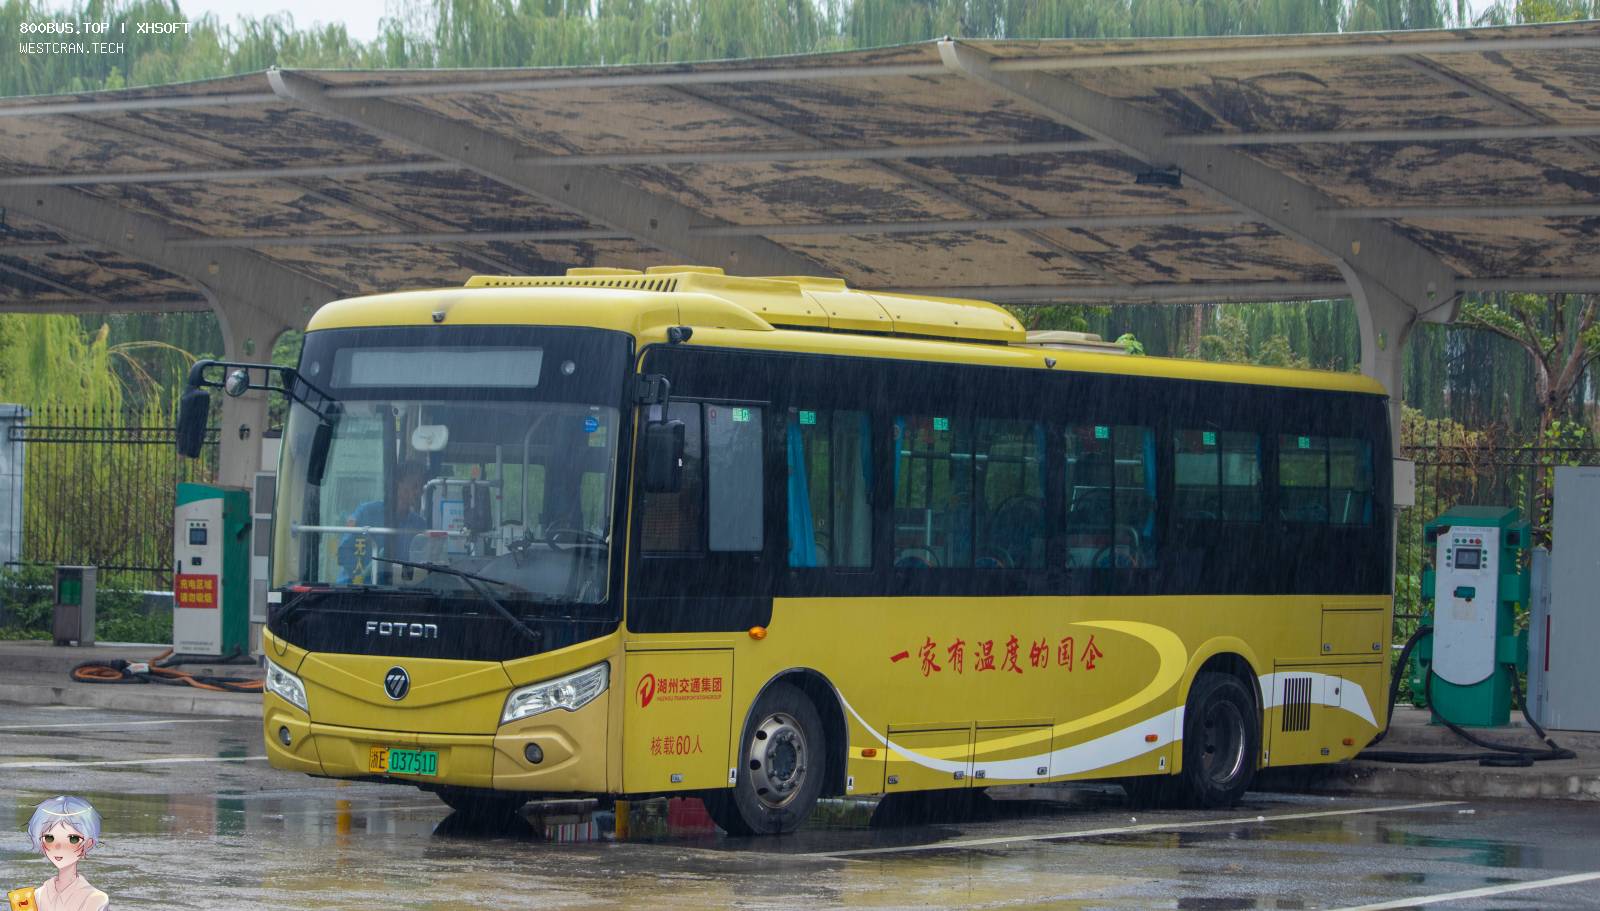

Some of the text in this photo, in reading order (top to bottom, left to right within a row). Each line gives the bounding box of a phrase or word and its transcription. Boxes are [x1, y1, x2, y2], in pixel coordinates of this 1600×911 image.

[365, 621, 438, 639] FOTON
[890, 634, 1104, 677] 一家有温度的国企
[657, 677, 723, 694] 湖州交通集团
[650, 734, 703, 756] 核载60人
